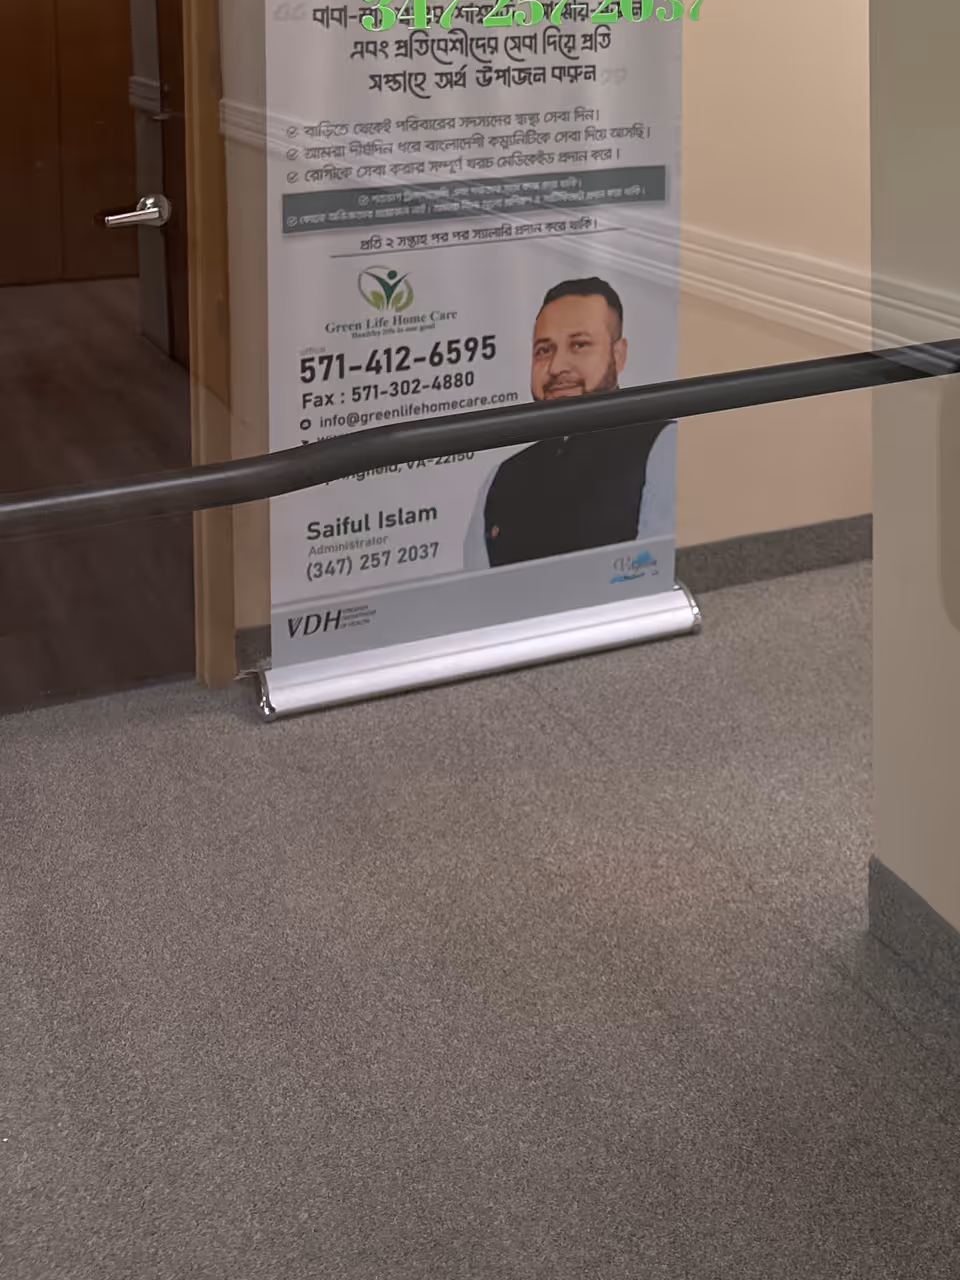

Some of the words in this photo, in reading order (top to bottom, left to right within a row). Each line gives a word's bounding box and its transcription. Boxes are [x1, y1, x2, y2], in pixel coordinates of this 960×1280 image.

[350, 41, 390, 60] এবং
[394, 28, 499, 65] প্রতিবেশীদের
[504, 33, 538, 63] সেবা
[542, 25, 580, 60] দিয়ে
[581, 24, 612, 53] প্রতি
[369, 70, 432, 100] সপ্তাহে
[434, 64, 468, 90] অর্থ
[550, 64, 597, 84] করুন
[395, 115, 456, 133] পরিবারের
[543, 111, 570, 124] সেবা
[554, 130, 581, 144] সেবা
[359, 235, 382, 251] প্রতি
[386, 239, 394, 249] ২
[431, 230, 449, 243] পর
[452, 229, 470, 241] পর
[325, 321, 363, 334] Green
[365, 316, 390, 331] Life
[392, 312, 427, 327] Home
[430, 310, 458, 322] Care
[300, 334, 497, 384] 571-412-6595
[302, 391, 335, 410] Fax
[351, 371, 475, 404] 571-302-4880
[319, 391, 519, 429] info@greenlifehomecare.com
[306, 513, 371, 541] Saiful
[378, 505, 438, 529] Islam
[306, 556, 353, 582] (347)
[359, 550, 391, 572] 257
[397, 541, 440, 564] 2037
[308, 535, 389, 557] Administrator
[287, 609, 343, 639] VDH
